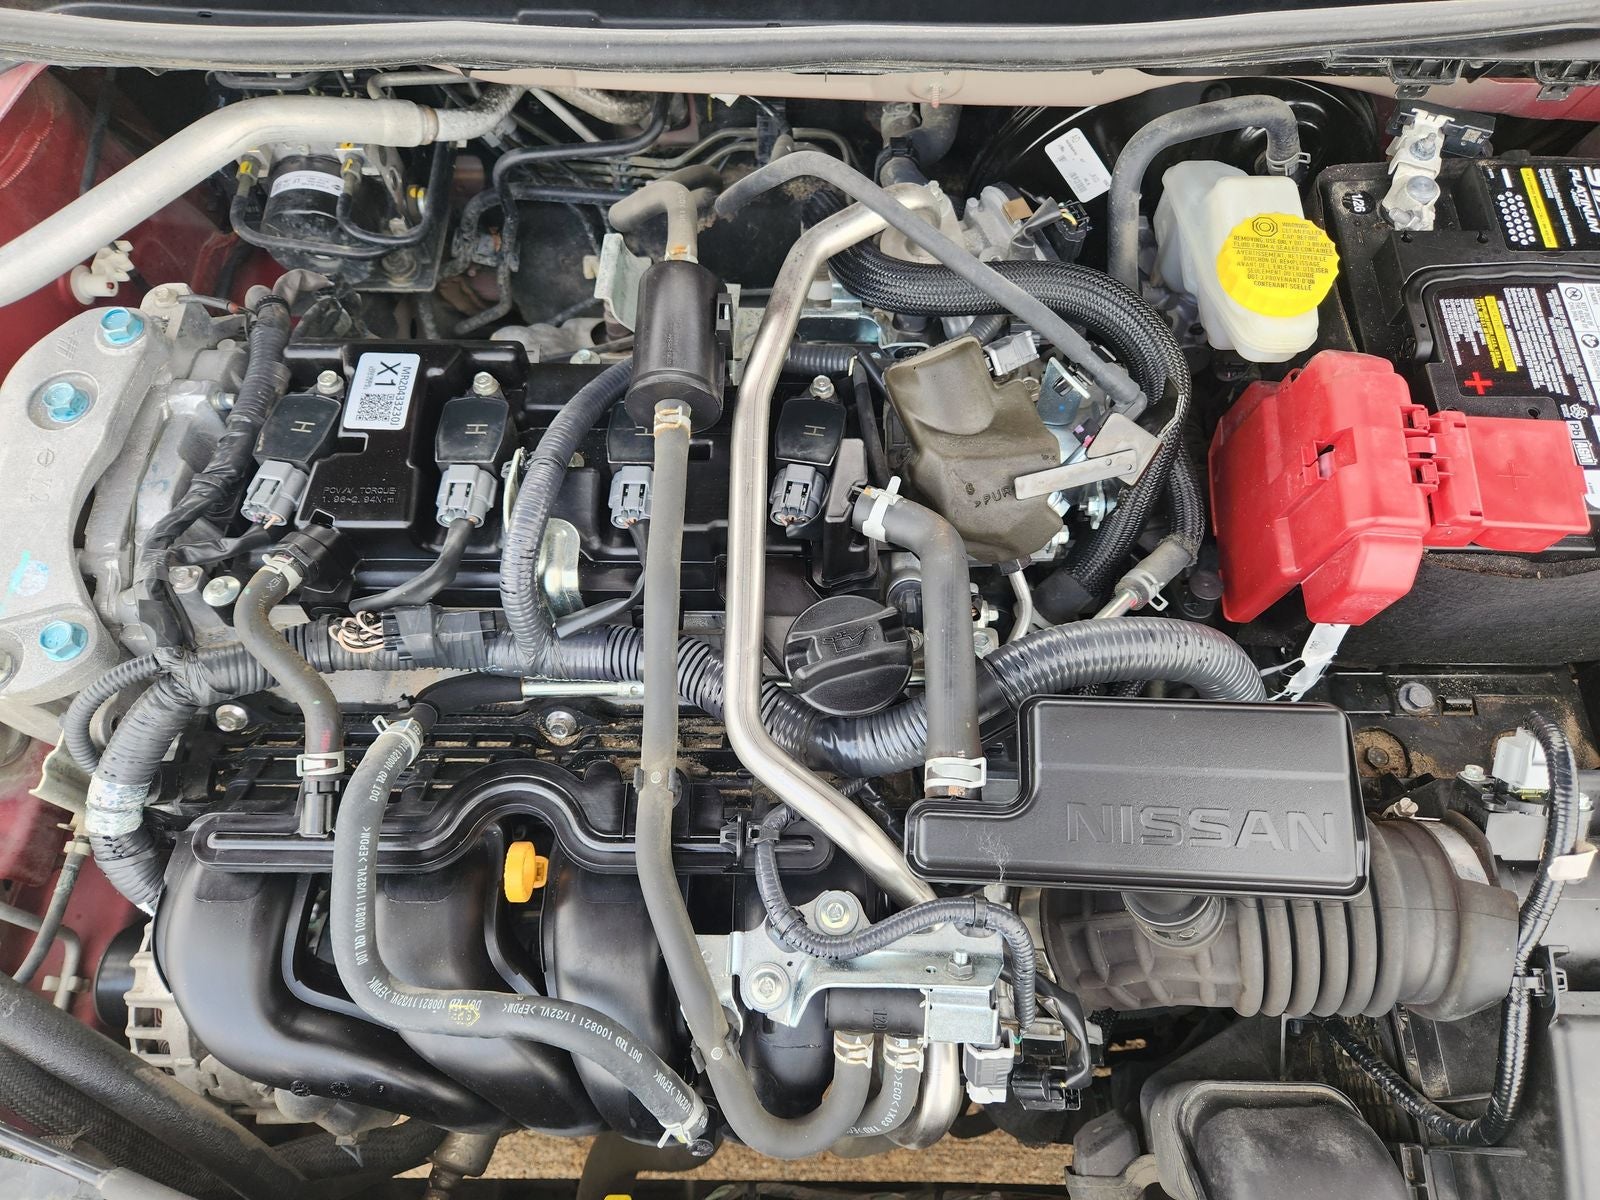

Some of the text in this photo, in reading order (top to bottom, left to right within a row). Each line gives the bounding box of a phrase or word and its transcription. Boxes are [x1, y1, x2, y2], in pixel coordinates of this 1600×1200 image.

[1352, 194, 1366, 212] 1/26
[1569, 168, 1600, 233] PLATINUM
[1570, 423, 1580, 436] Pb
[359, 486, 396, 495] TORQUE
[368, 784, 382, 802] DOT
[383, 749, 403, 771] 100821
[1067, 801, 1336, 852] NISSAN
[355, 902, 367, 933] 100821
[355, 950, 369, 966] DOT
[418, 998, 447, 1009] 100821
[578, 1016, 613, 1040] 100821
[629, 1046, 643, 1064] DOT
[881, 1108, 898, 1127] 1X03
